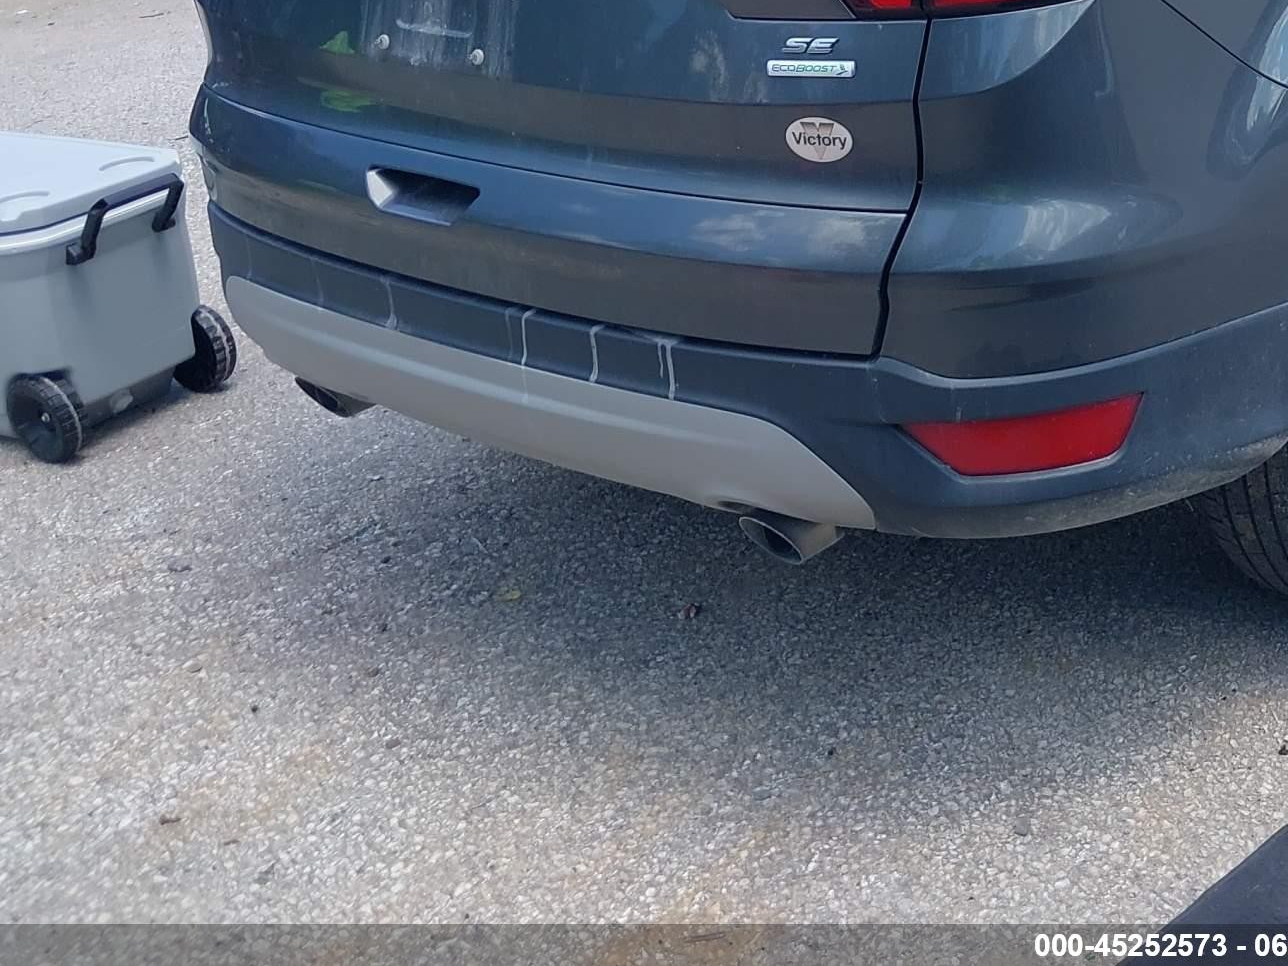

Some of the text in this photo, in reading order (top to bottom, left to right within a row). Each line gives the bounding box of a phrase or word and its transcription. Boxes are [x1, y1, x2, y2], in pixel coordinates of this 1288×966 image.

[781, 37, 840, 54] SE
[771, 63, 838, 73] ECOBOOST
[791, 131, 848, 150] Victory
